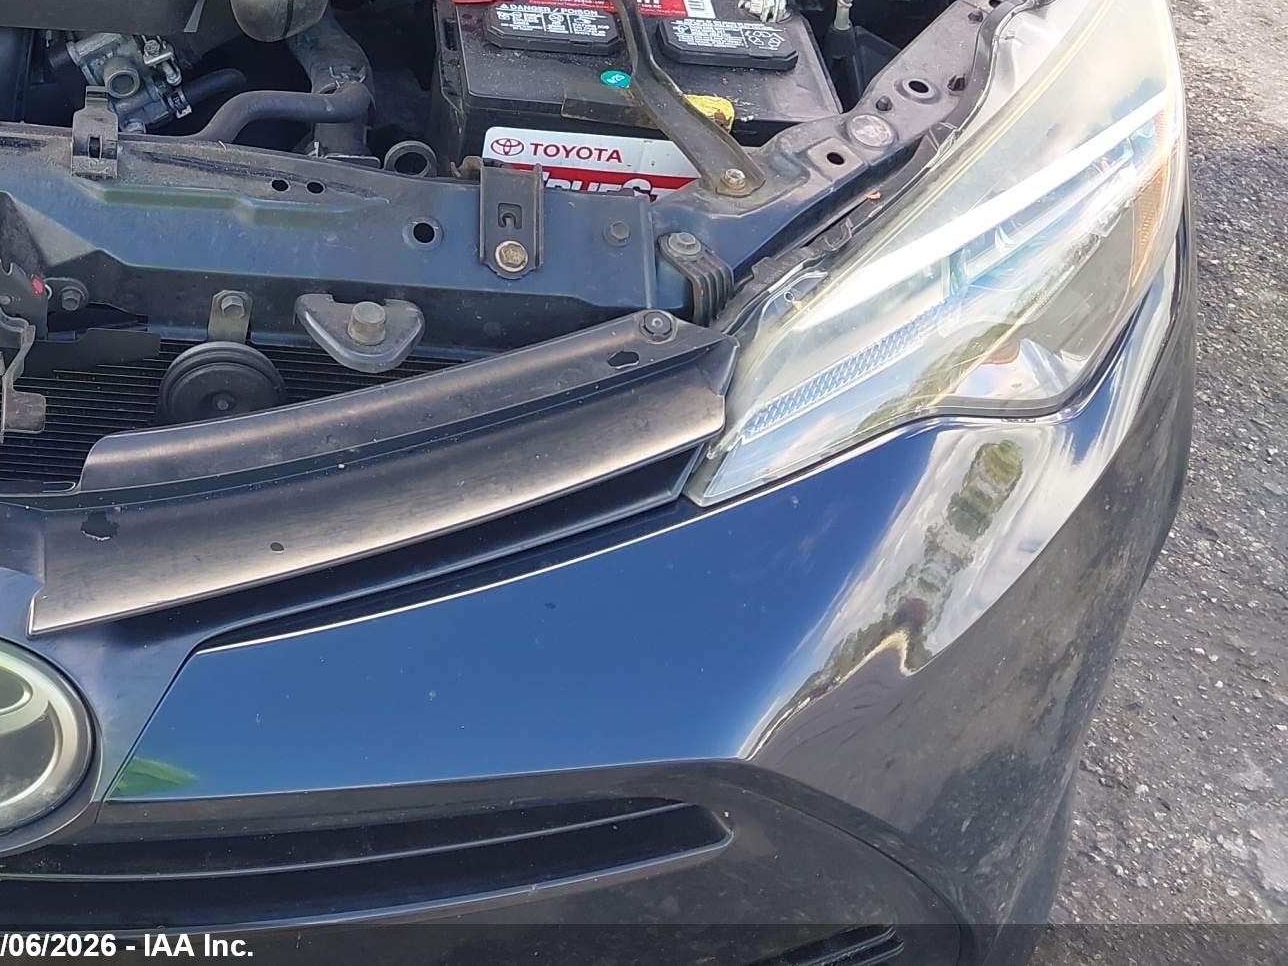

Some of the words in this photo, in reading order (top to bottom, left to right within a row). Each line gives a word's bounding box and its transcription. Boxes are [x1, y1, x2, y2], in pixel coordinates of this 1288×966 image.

[509, 4, 551, 13] DANGER
[561, 8, 599, 16] POISON
[530, 142, 623, 164] TOYOTA
